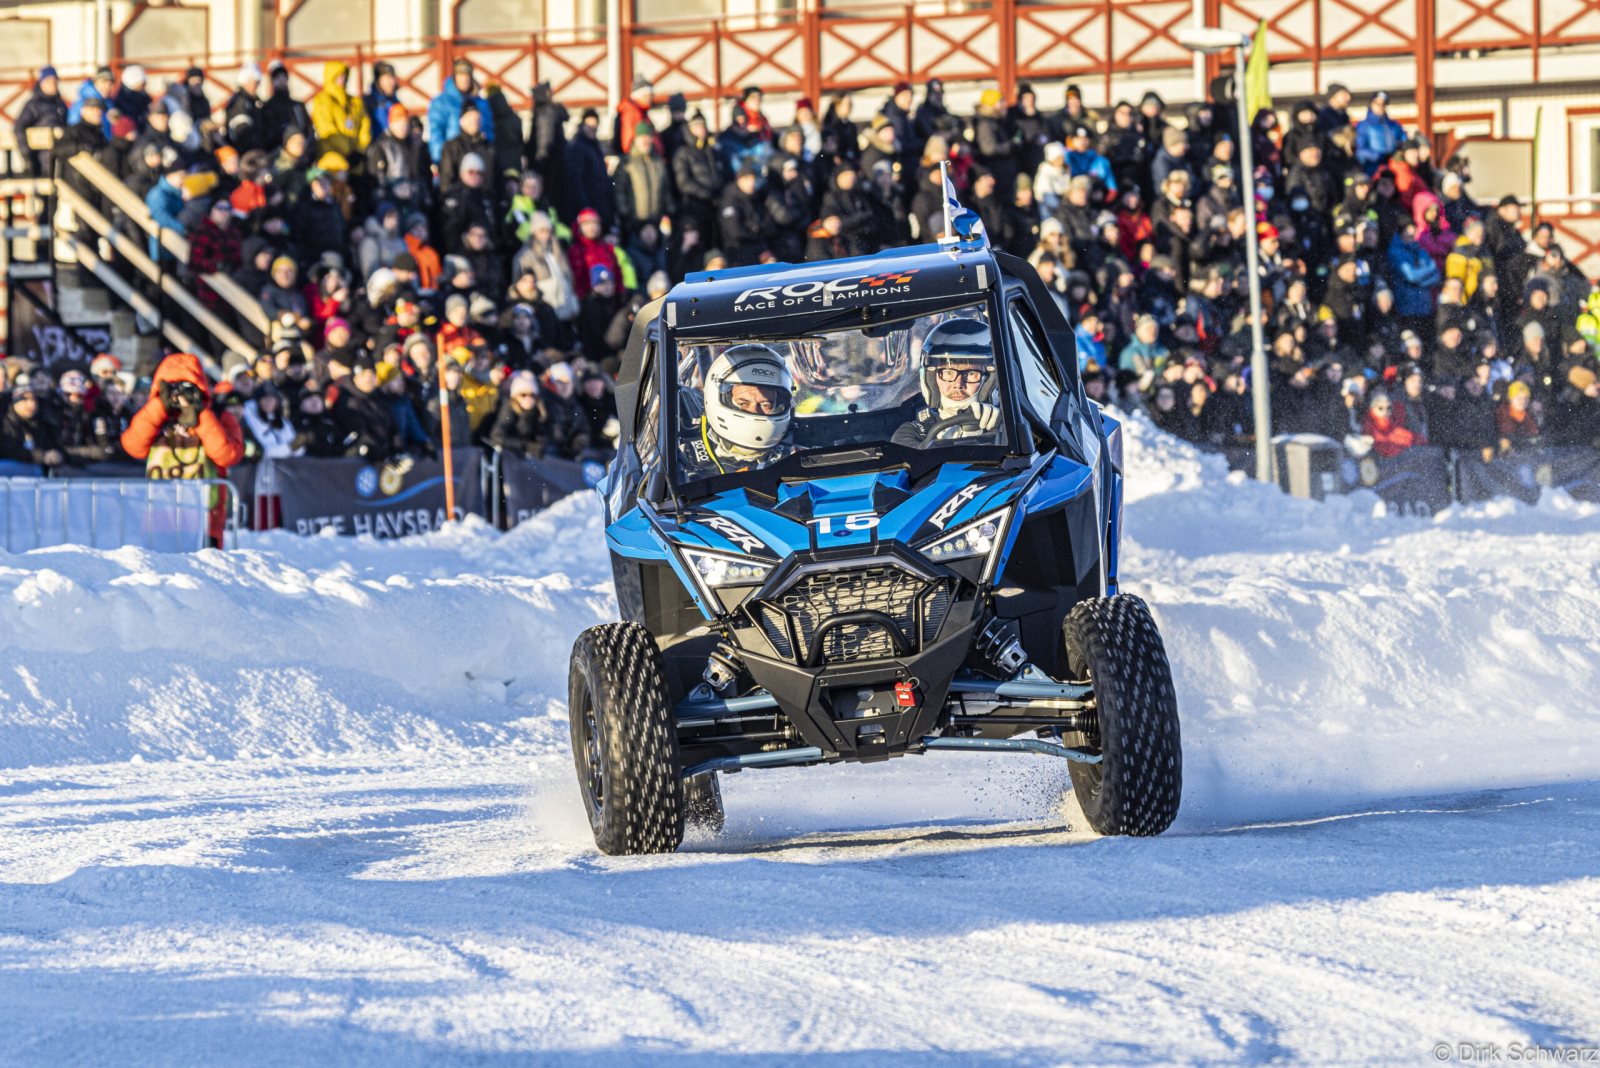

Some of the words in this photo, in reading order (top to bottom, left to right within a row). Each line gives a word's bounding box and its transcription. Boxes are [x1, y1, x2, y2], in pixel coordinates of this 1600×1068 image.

[734, 275, 868, 304] ROC
[734, 300, 776, 313] RACE
[782, 297, 804, 306] OF
[811, 285, 911, 303] CHAMPIONS
[928, 484, 988, 530] RZR
[695, 516, 765, 554] RZR
[806, 512, 880, 534] 15
